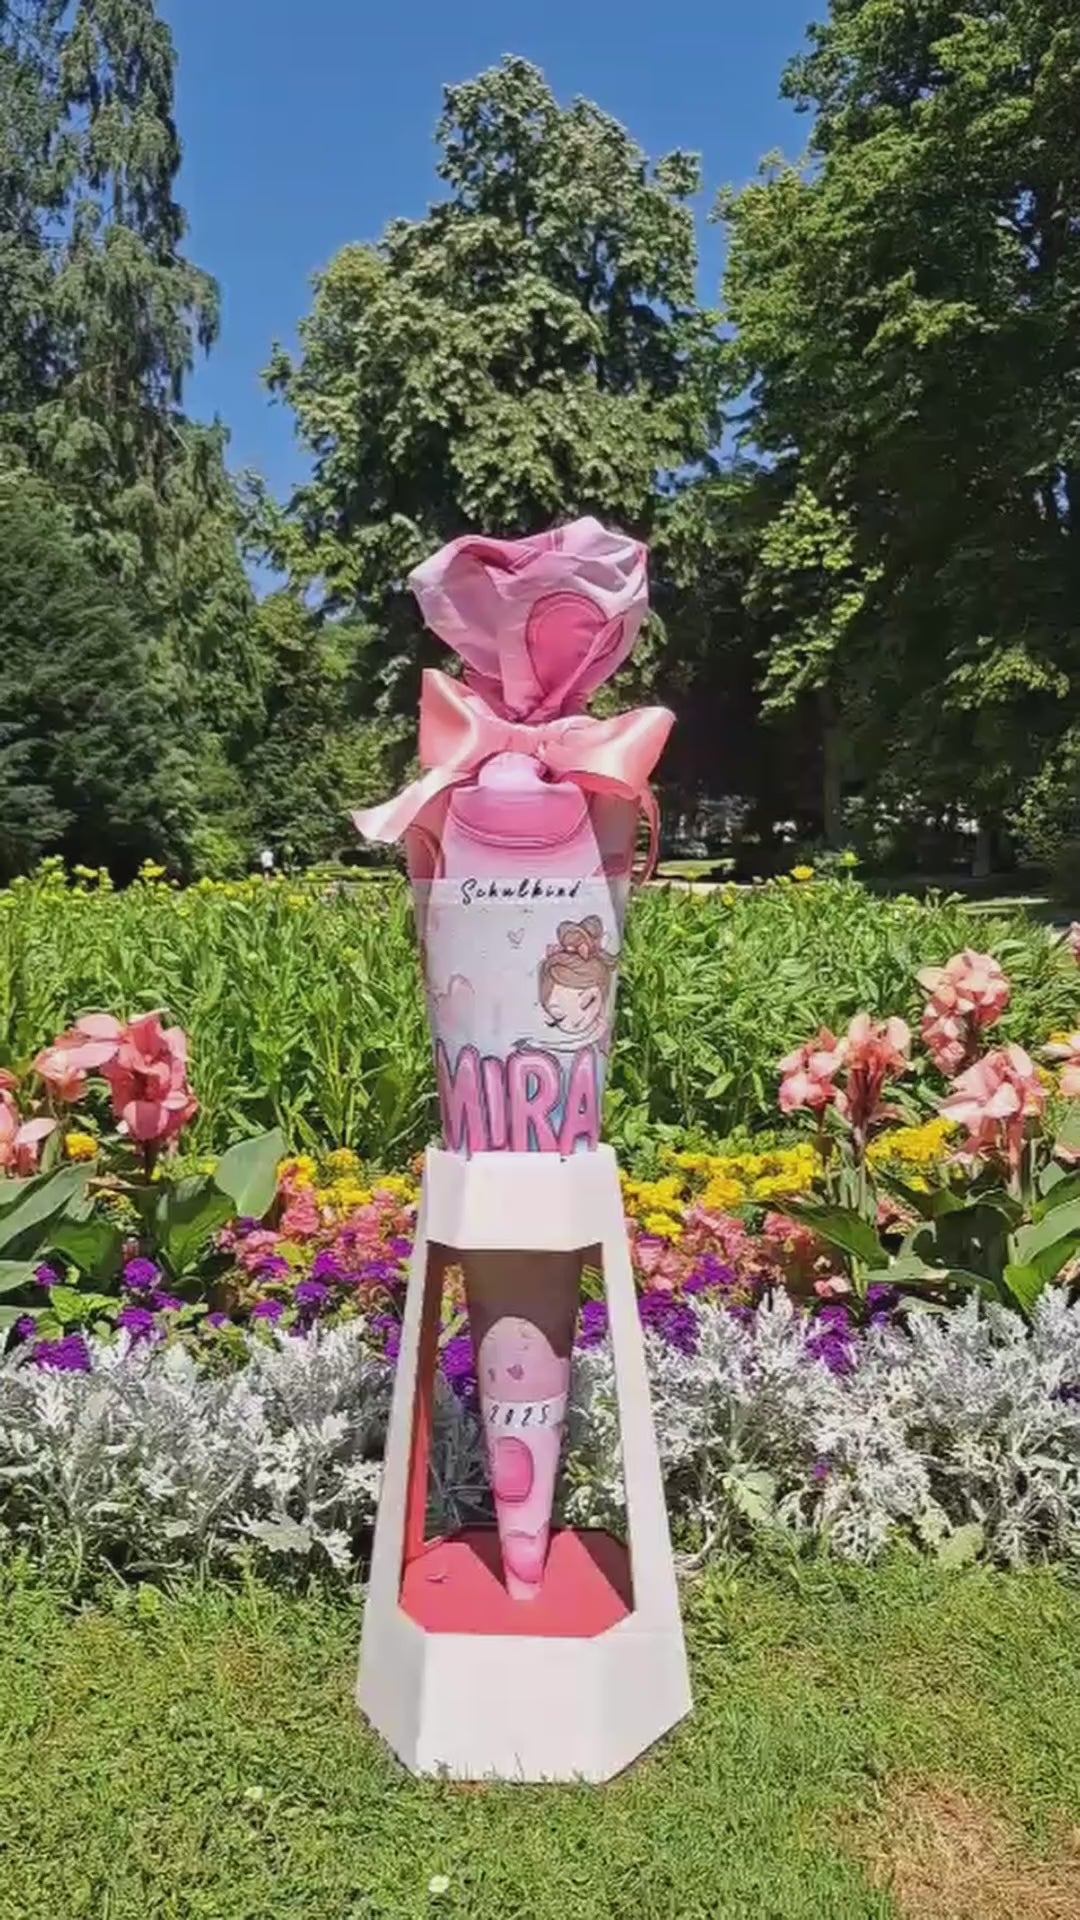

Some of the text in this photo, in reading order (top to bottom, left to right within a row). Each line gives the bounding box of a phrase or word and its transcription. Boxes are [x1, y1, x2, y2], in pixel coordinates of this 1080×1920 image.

[460, 878, 582, 905] Schulkind
[436, 1038, 600, 1157] MIRA
[488, 1404, 550, 1427] 2025
